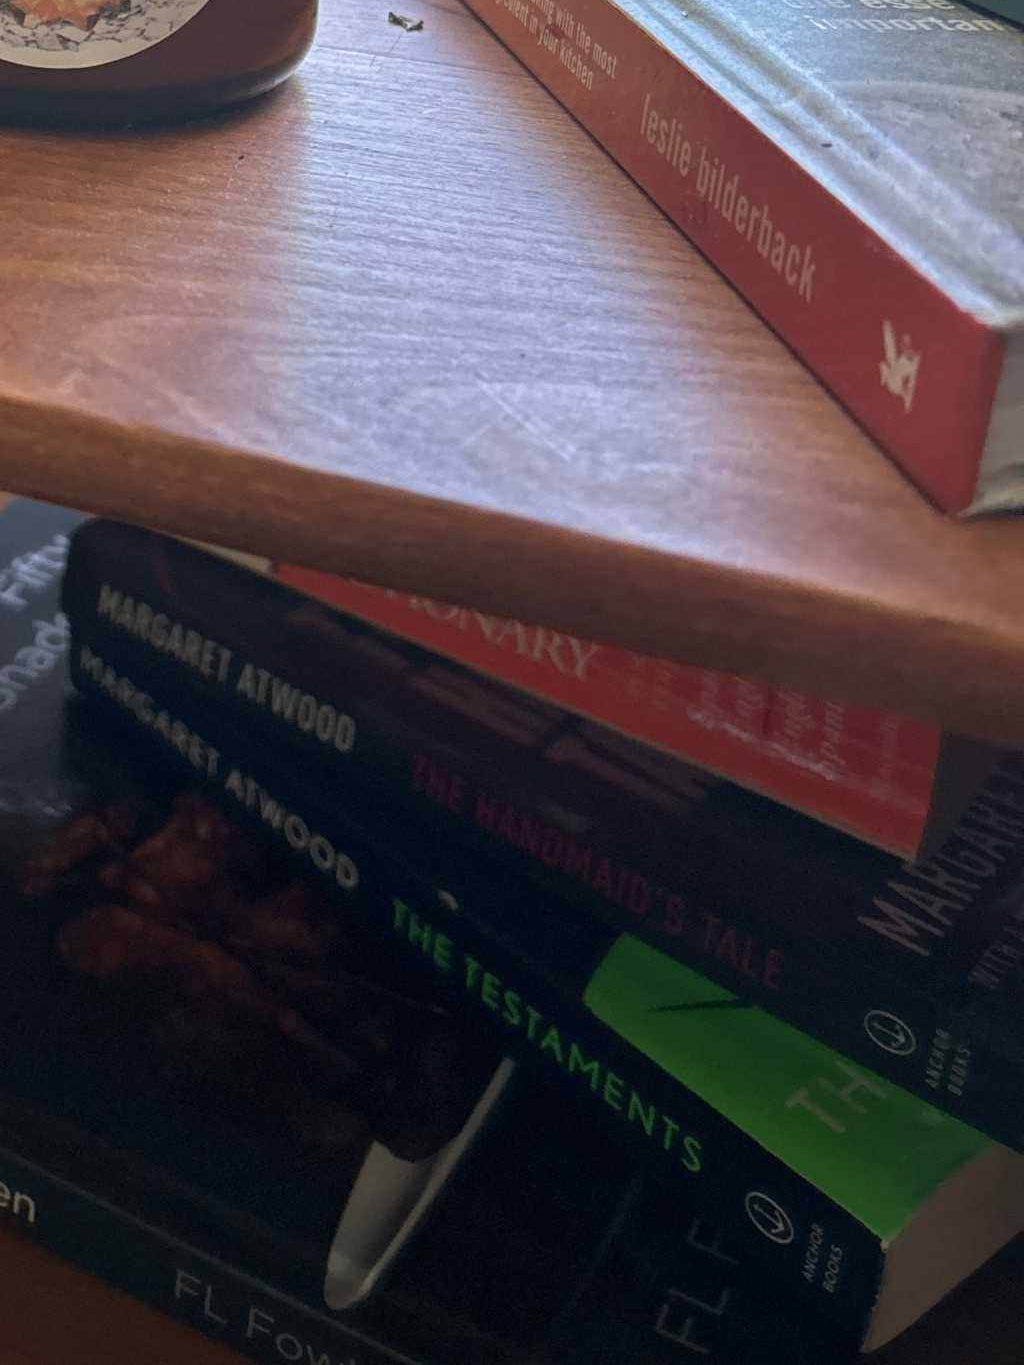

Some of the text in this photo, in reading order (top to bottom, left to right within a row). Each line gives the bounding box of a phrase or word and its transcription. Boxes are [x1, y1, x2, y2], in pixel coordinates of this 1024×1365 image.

[537, 23, 559, 54] your
[559, 38, 594, 91] kitchen
[555, 5, 576, 38] with
[576, 22, 591, 54] the
[592, 42, 618, 80] most
[640, 93, 816, 305] leslie bilderback
[97, 583, 357, 754] MARGARET ATWOOD
[225, 769, 359, 889] ATWOOD
[701, 911, 784, 990] TALE
[391, 897, 702, 1173] THE TESTAMENTS
[799, 1222, 826, 1283] ANCHOR
[821, 1243, 845, 1294] BOOKS
[174, 1269, 228, 1325] FL
